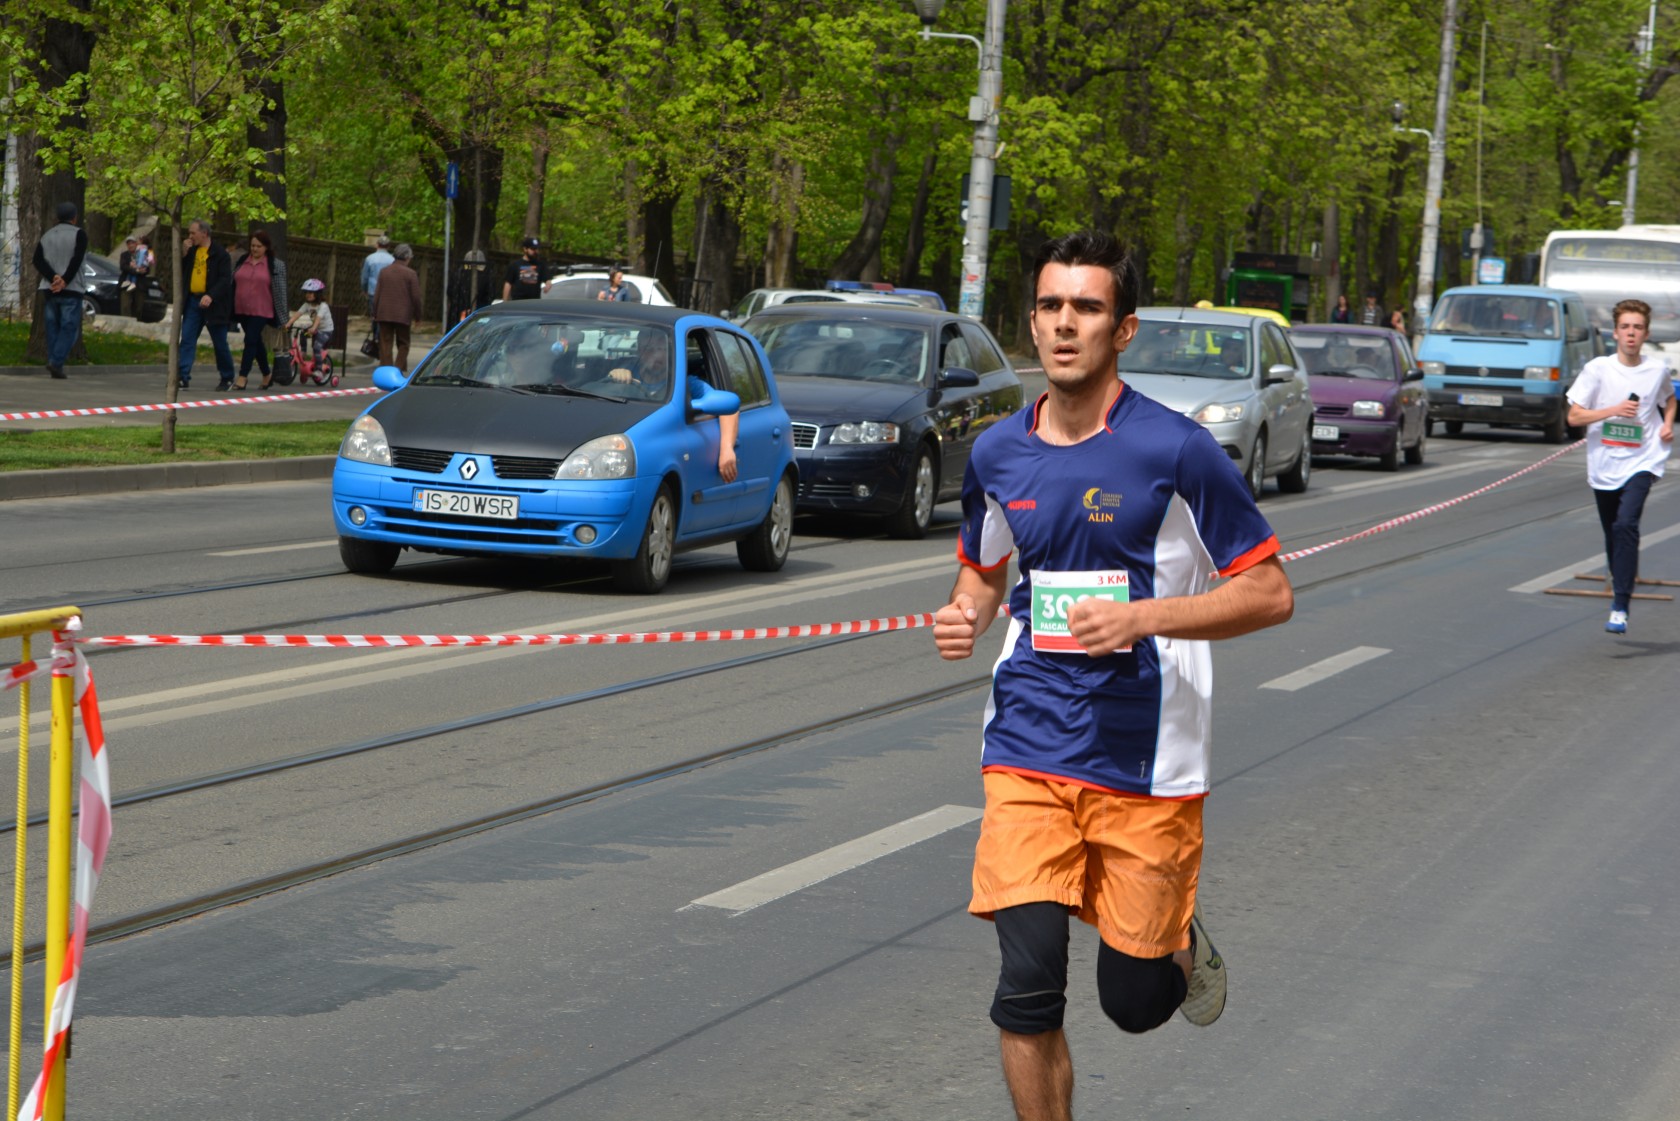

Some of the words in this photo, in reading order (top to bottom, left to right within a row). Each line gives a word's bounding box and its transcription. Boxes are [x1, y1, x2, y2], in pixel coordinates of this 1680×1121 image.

[1609, 425, 1635, 437] 3131
[426, 492, 442, 510] IS
[449, 495, 470, 512] 20
[473, 496, 514, 516] WSR
[1088, 512, 1114, 522] ALIN
[1097, 575, 1104, 585] 3
[1107, 575, 1127, 585] KM
[1040, 593, 1114, 619] 30
